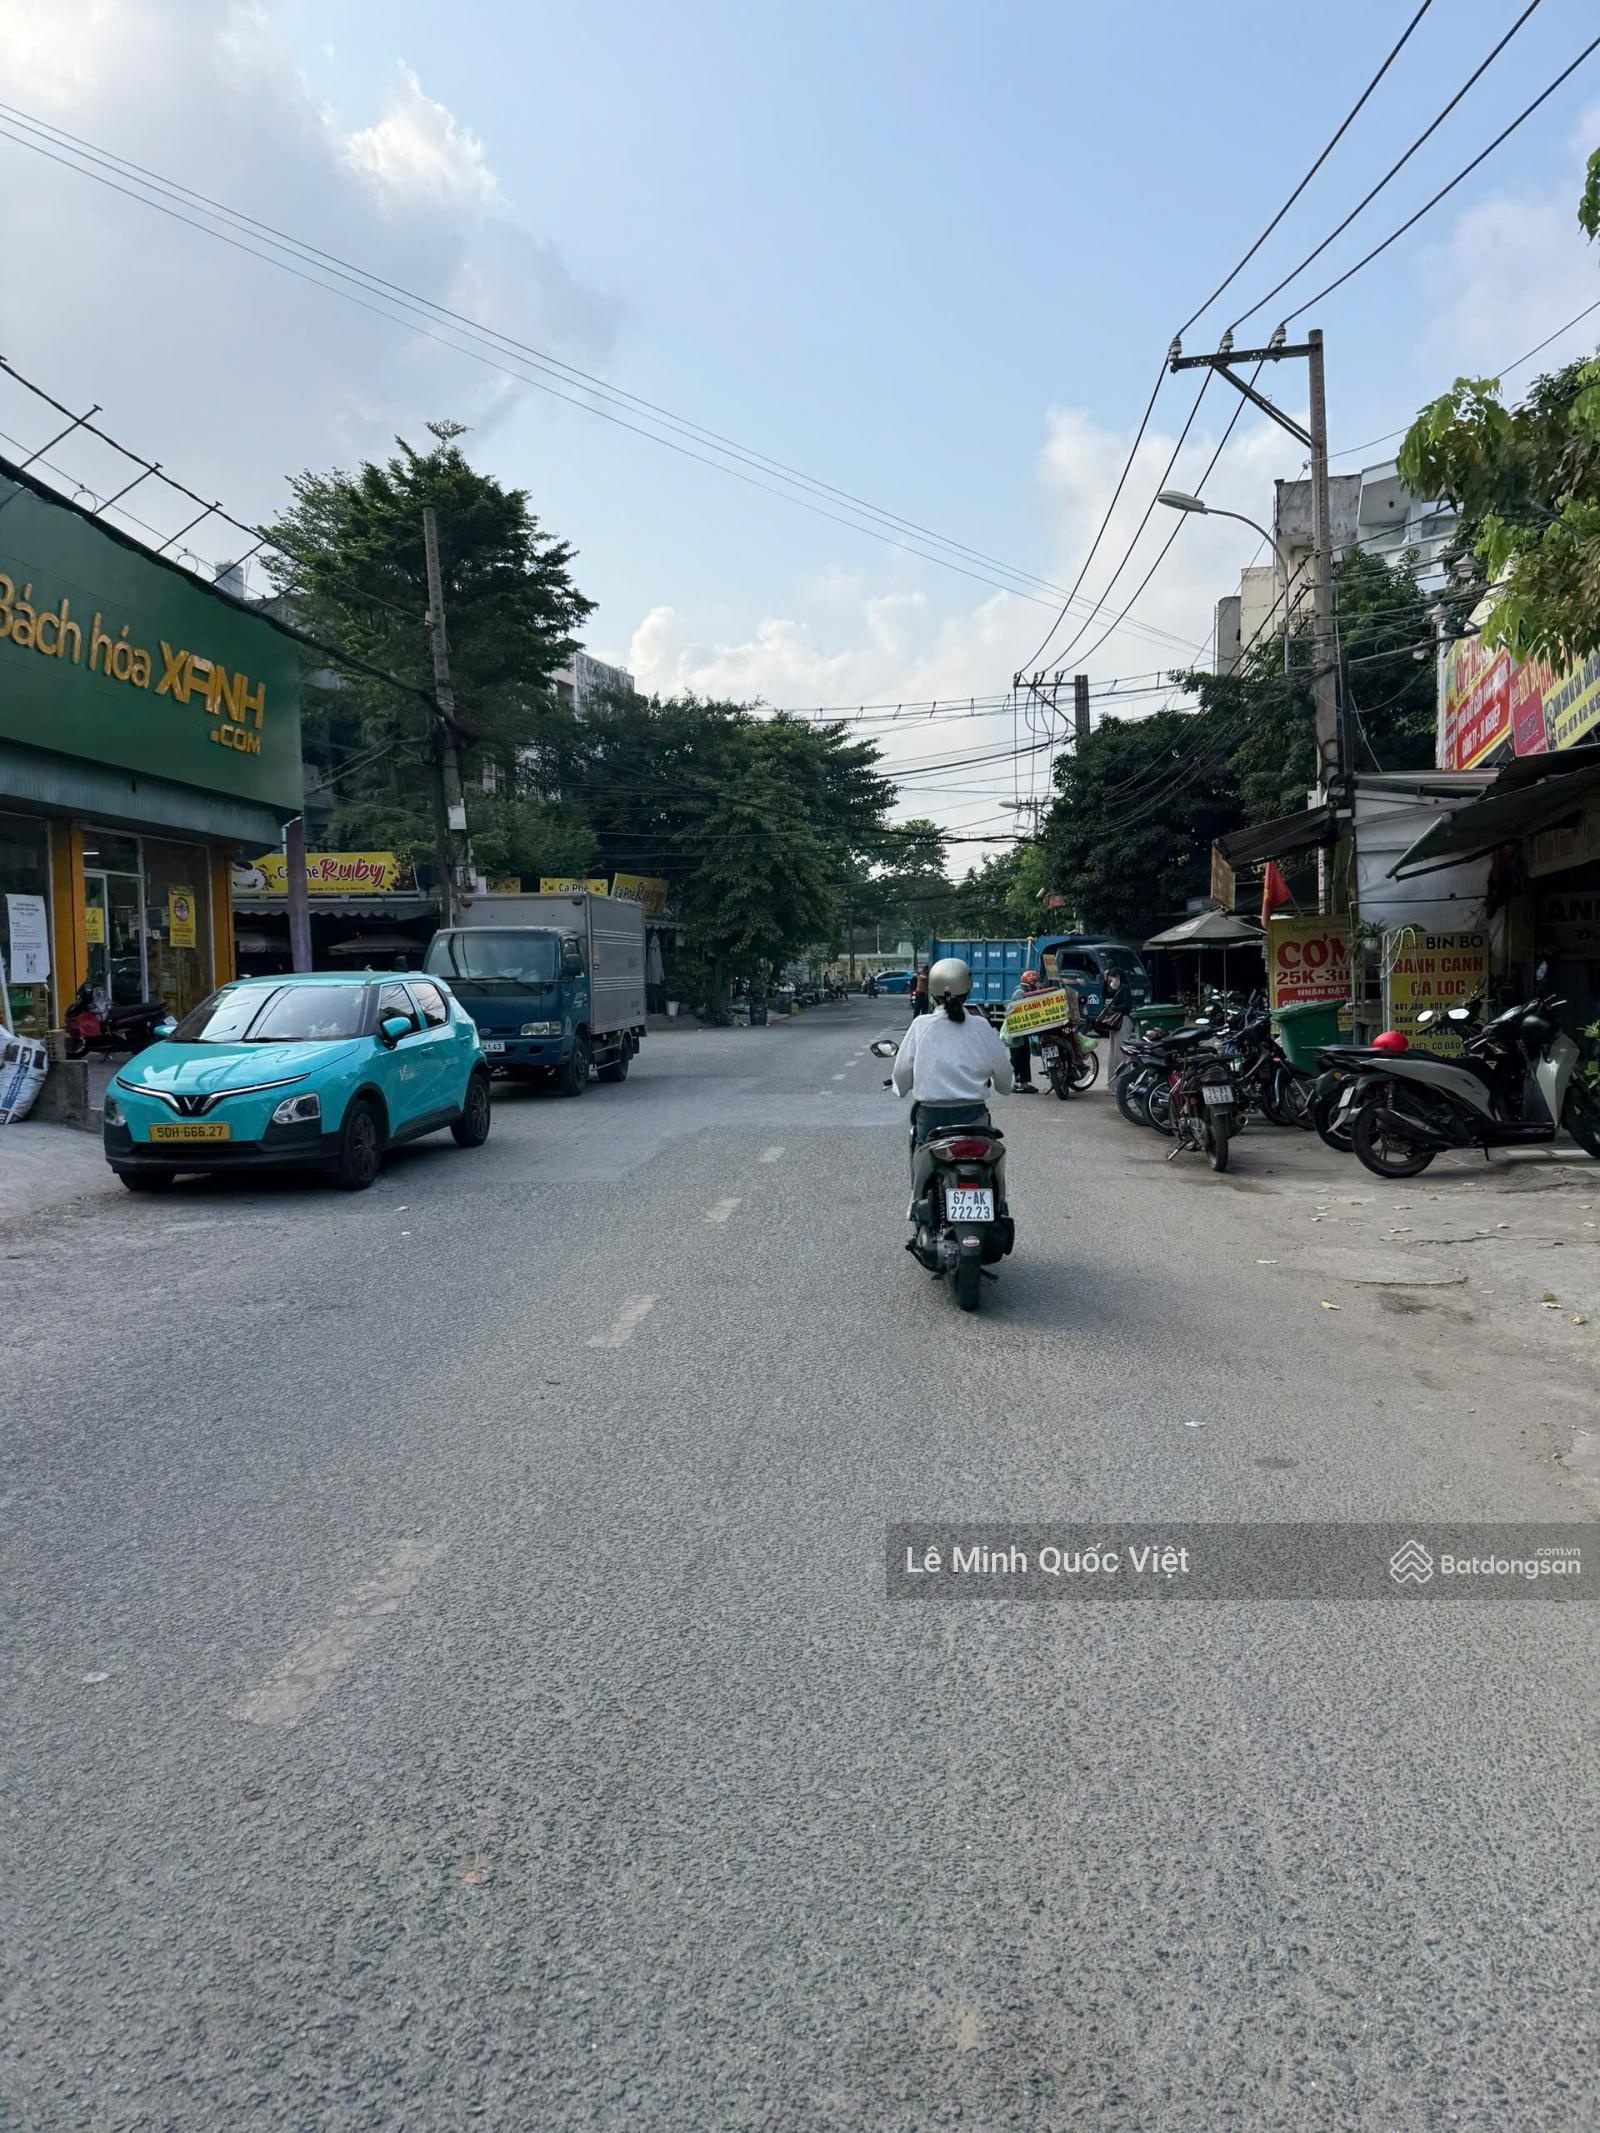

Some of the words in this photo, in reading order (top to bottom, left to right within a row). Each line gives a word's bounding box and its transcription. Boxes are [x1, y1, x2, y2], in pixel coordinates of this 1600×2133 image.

[0, 573, 81, 664] Bách
[89, 612, 152, 689] hóa
[154, 640, 266, 729] XANH
[210, 724, 261, 755] .COM
[319, 857, 386, 887] Ruby
[1426, 936, 1454, 950] BIN
[1440, 956, 1483, 973] CANH
[156, 1125, 224, 1138] 50H-666.27
[953, 1191, 986, 1205] 67-AK
[951, 1206, 990, 1220] 222.23
